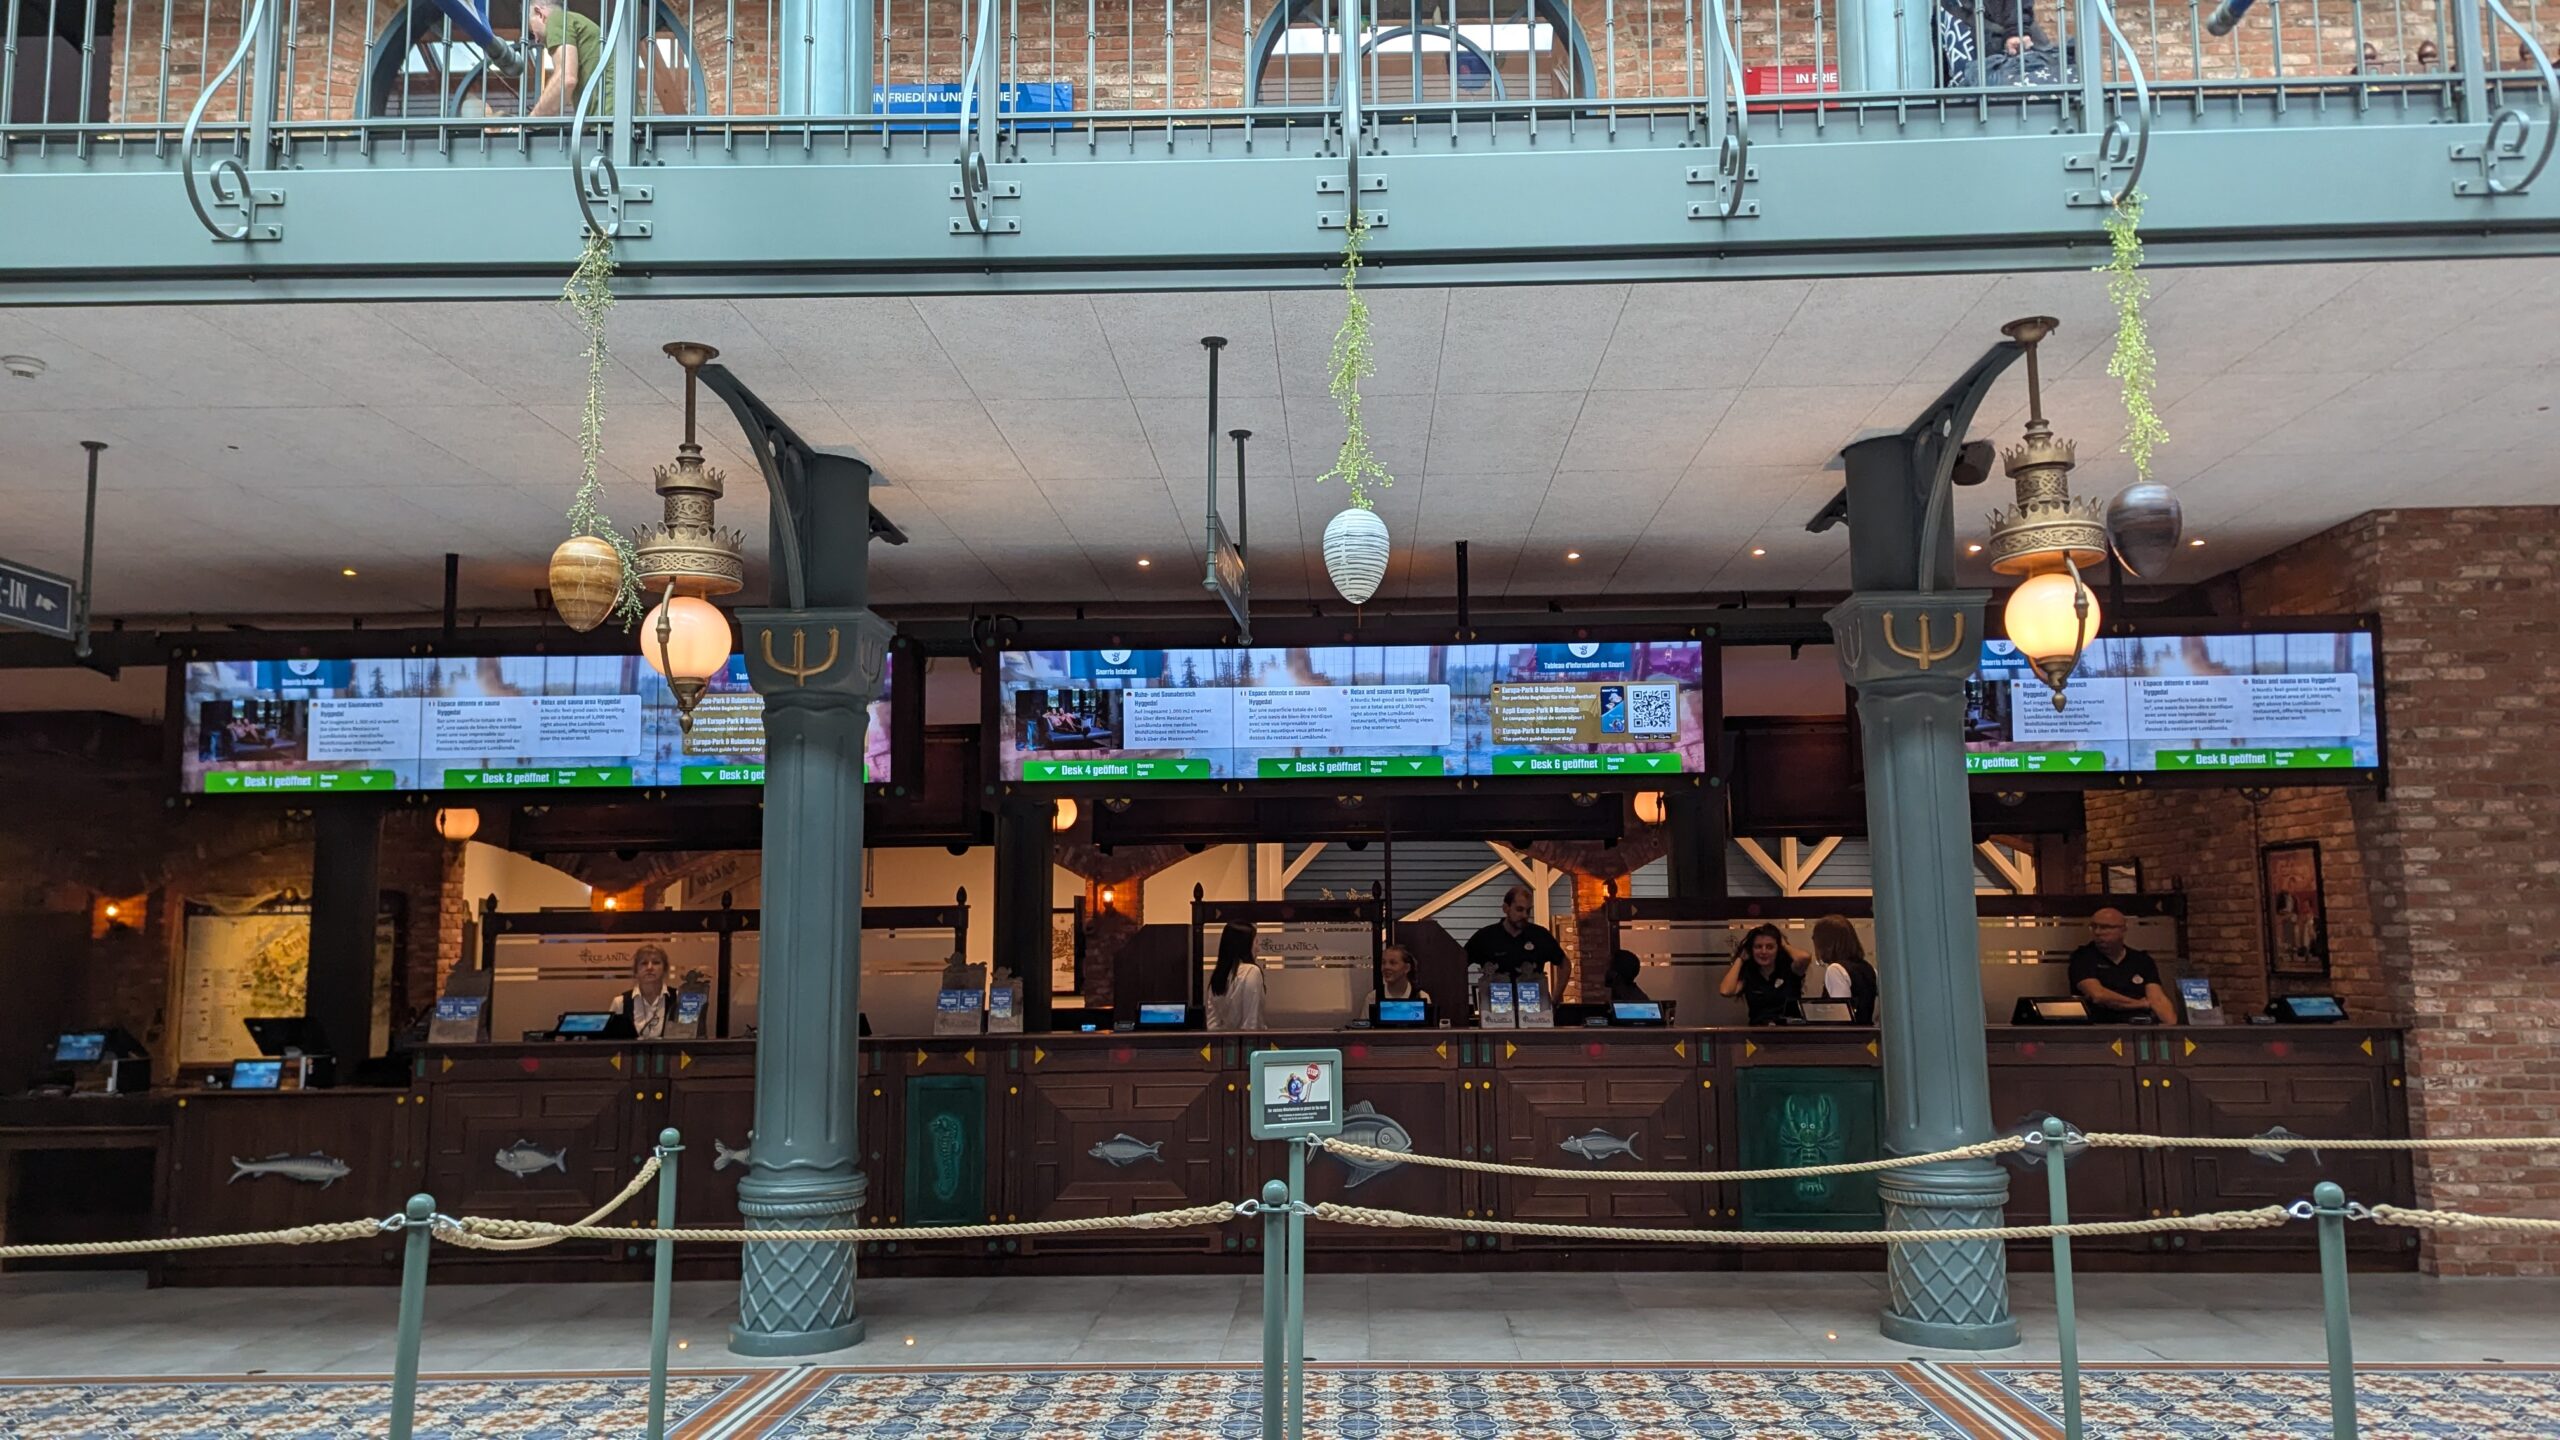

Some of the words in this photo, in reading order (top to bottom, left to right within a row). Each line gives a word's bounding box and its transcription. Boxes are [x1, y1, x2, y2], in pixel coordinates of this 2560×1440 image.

[1796, 74, 1810, 84] IN
[1812, 72, 1838, 83] FRIE
[873, 92, 884, 102] IN
[888, 92, 938, 102] FRIEDEN
[1296, 762, 1317, 772] Desk
[1319, 762, 1324, 772] 5
[1326, 762, 1361, 774] geöffnet
[1531, 760, 1552, 768] Desk
[1554, 760, 1560, 768] 6
[1562, 759, 1598, 770] geöffnet
[1981, 758, 2019, 769] geöffnet
[1061, 766, 1083, 775] Desk
[1085, 766, 1090, 775] 4
[1092, 765, 1128, 776] geöffnet
[244, 776, 266, 786] Desk
[274, 776, 312, 788] geöffnet
[482, 774, 504, 783] Desk
[506, 773, 512, 783] 2
[514, 773, 550, 784] geöffnet
[1268, 941, 1320, 952] RULANTICA
[588, 950, 631, 962] RULANTIC
